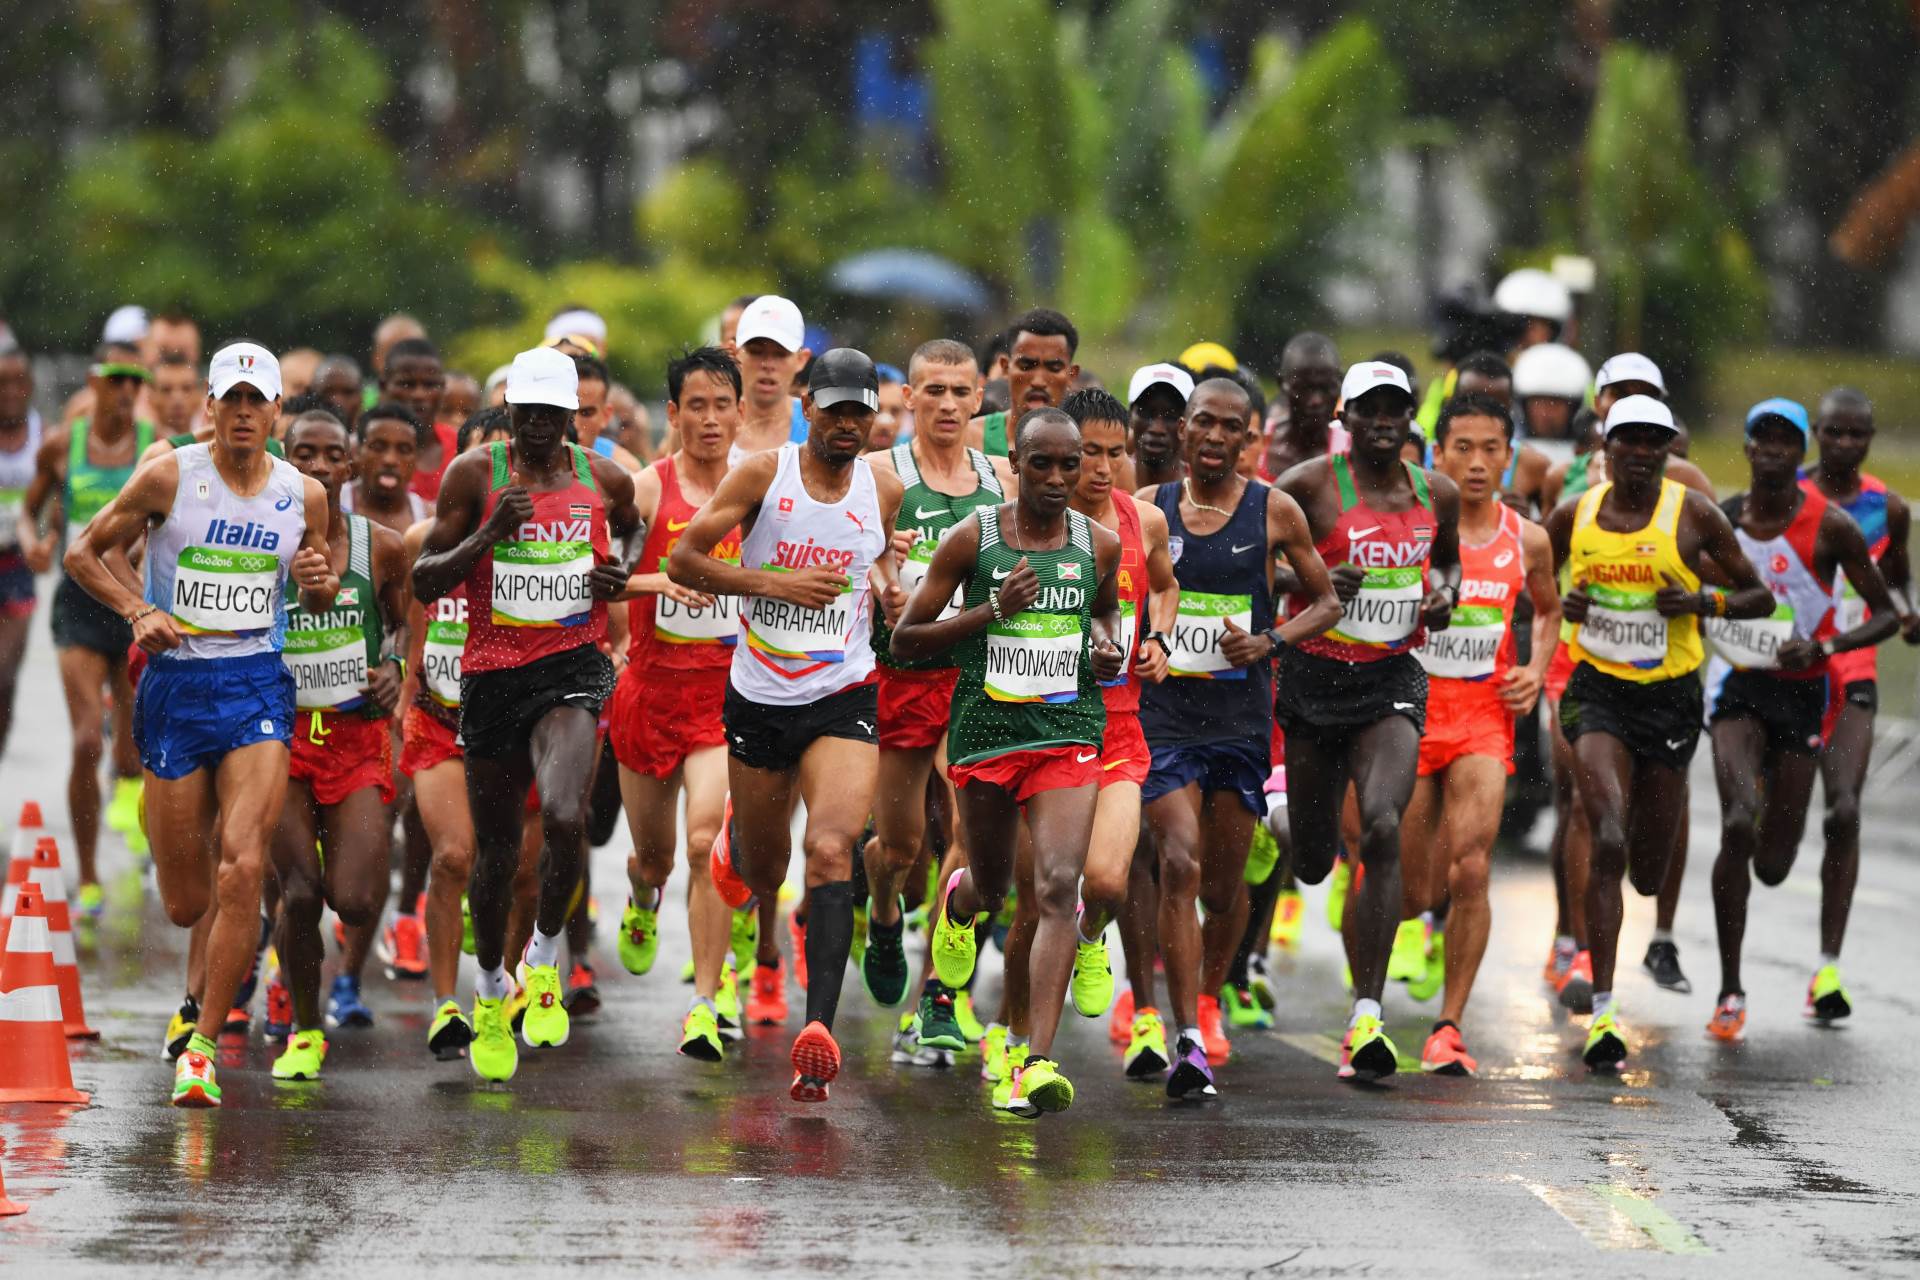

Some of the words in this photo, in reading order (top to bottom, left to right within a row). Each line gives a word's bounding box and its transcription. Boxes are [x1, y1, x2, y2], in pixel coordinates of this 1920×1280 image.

[205, 519, 280, 551] Italia
[509, 520, 591, 542] ENYA
[192, 552, 233, 567] Rio2016
[508, 547, 550, 558] Rio2016
[176, 578, 271, 614] MEUCCI
[495, 574, 591, 602] KIPCHOGE
[1459, 578, 1510, 602] pan
[288, 609, 365, 632] URUNDI
[752, 597, 845, 636] ABRAHAM
[1001, 619, 1044, 632] Rio2016
[1175, 624, 1228, 654] KOK
[1417, 633, 1497, 662] HIKAWA
[290, 656, 366, 690] ORIMBERE
[989, 645, 1079, 678] NIYONKURU
